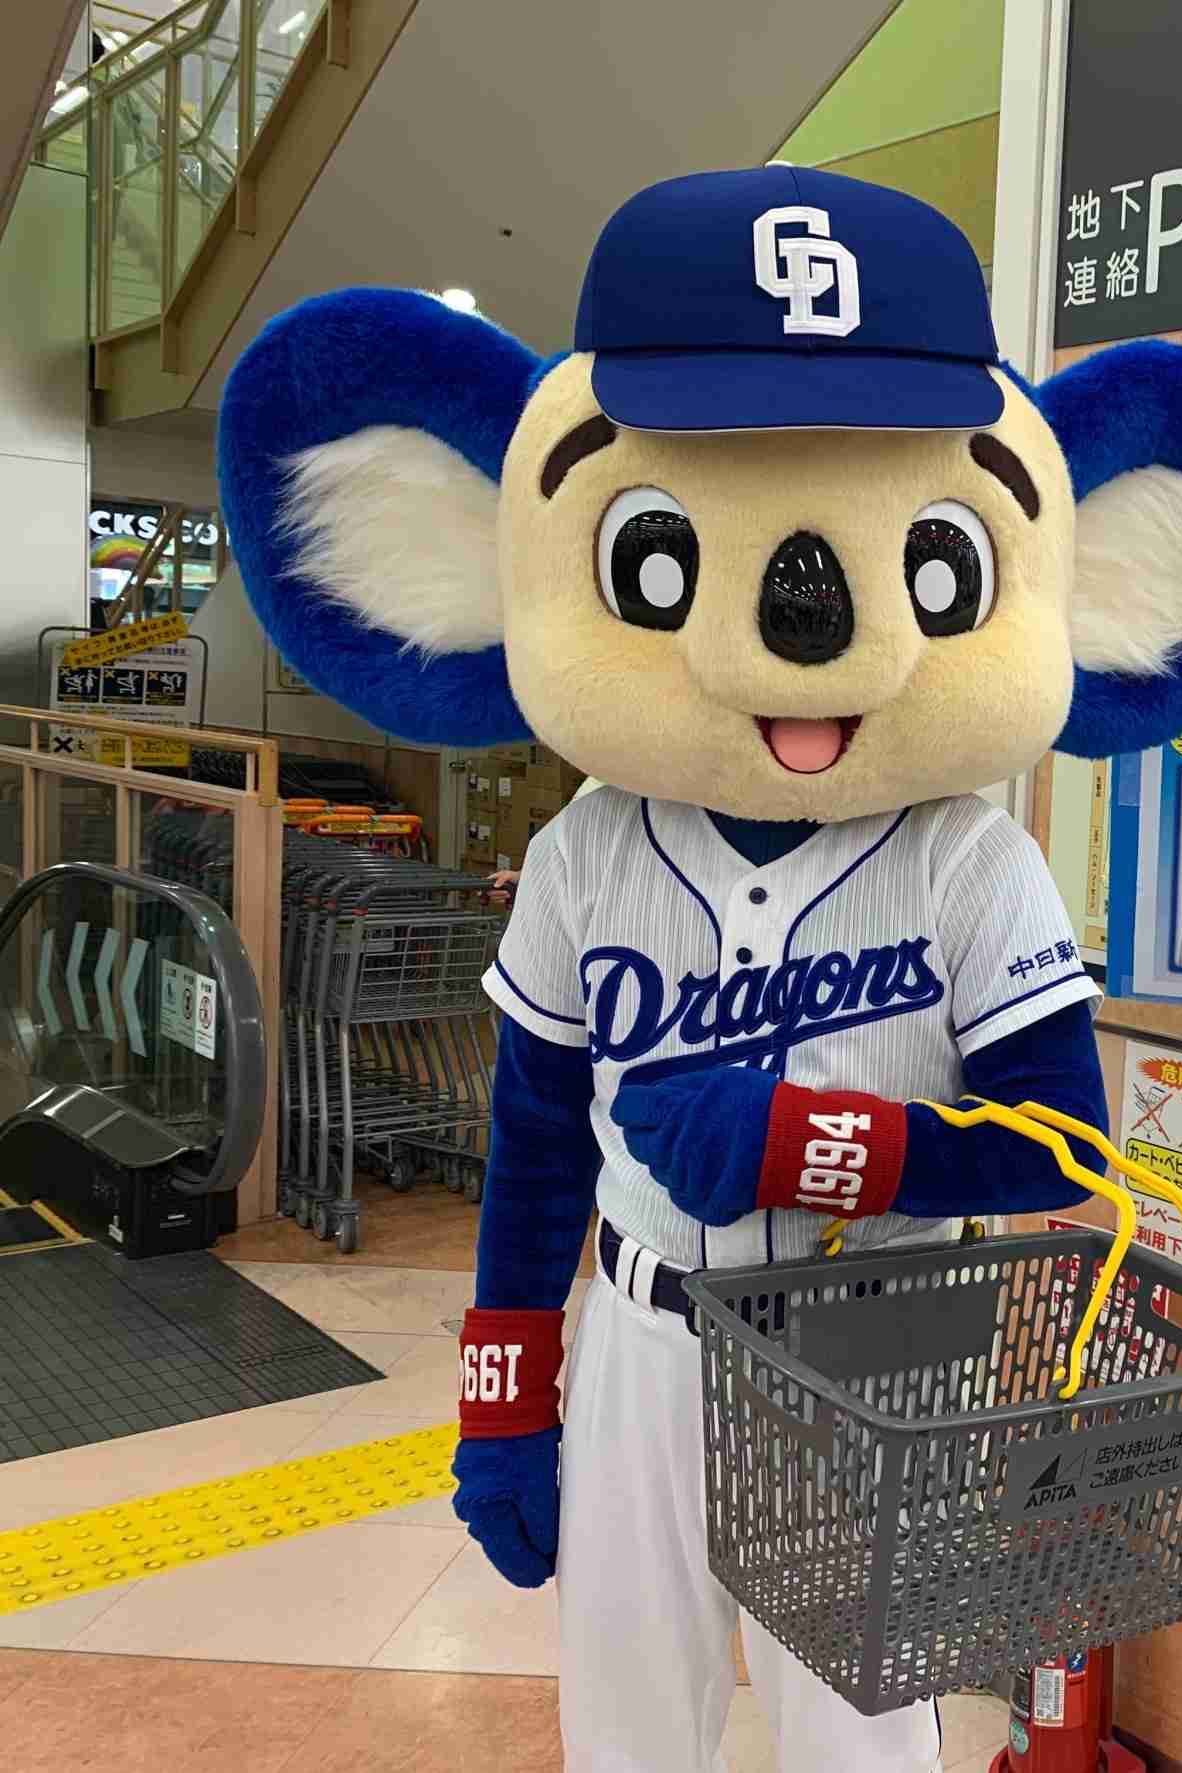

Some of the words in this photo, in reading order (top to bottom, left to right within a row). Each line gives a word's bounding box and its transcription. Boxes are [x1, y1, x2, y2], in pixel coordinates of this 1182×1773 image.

[1066, 179, 1145, 241] 地下
[1063, 247, 1141, 308] 連絡
[580, 936, 943, 1076] Dragons
[795, 1111, 872, 1211] 1994
[464, 1344, 523, 1402] 199
[1024, 1483, 1077, 1511] APITA
